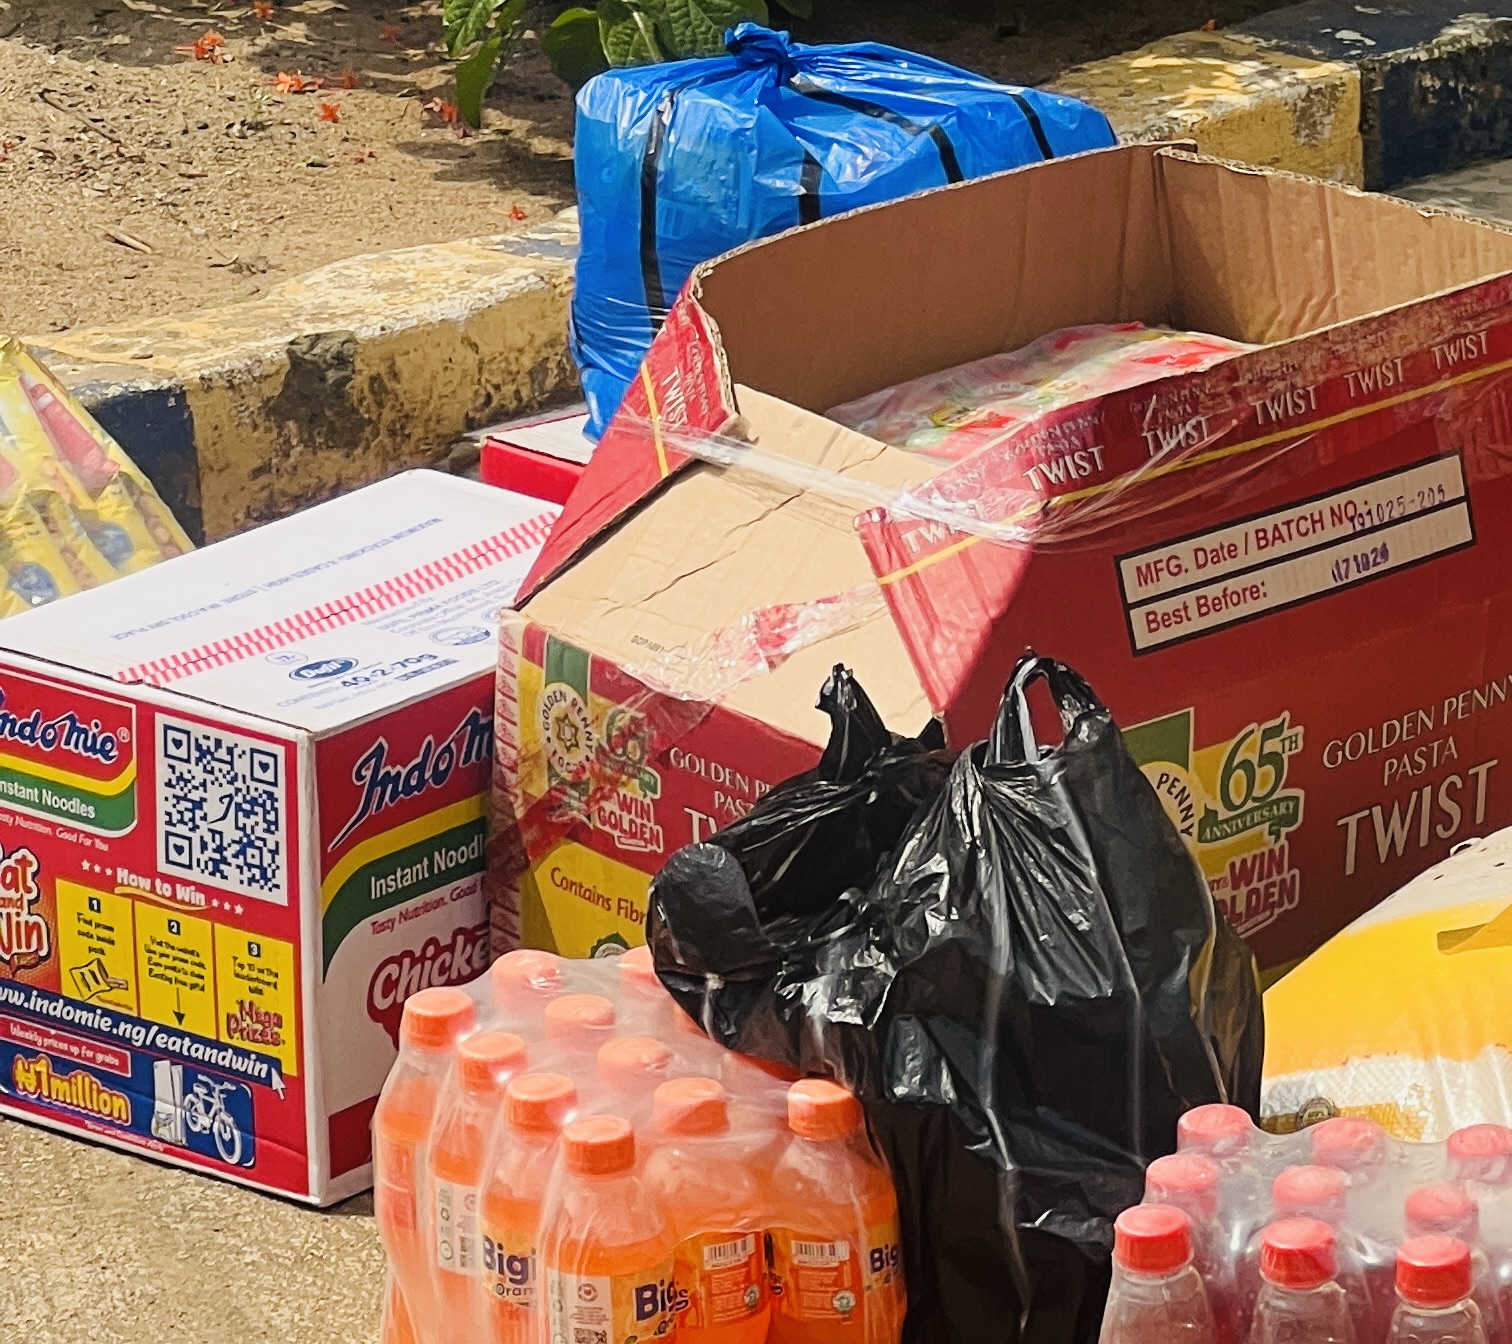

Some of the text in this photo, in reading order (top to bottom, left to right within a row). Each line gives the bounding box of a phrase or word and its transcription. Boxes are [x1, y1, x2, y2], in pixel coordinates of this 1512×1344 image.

[1431, 331, 1488, 370] TWIST
[1343, 358, 1404, 398] TWIST
[1252, 385, 1318, 425] TWIST
[1142, 417, 1209, 456] TWIST
[1023, 446, 1104, 491] TWIST
[1136, 554, 1189, 588] MFG.
[1194, 539, 1238, 570] Date
[1255, 511, 1325, 552] BATCH
[1145, 602, 1192, 634] Best
[1195, 580, 1268, 619] Before:
[542, 689, 567, 732] GOLDEN
[0, 709, 118, 764] ndomie
[1322, 704, 1435, 770] GOLDEN
[670, 747, 749, 793] GOLDEN
[1383, 735, 1458, 787] PASTA
[0, 779, 96, 819] nstant Noodles
[616, 790, 653, 823] WIN
[714, 790, 755, 816] PAS
[1156, 772, 1195, 837] PENNY
[1202, 799, 1297, 840] ANNIVERSARY
[1337, 758, 1498, 877] TWIST
[598, 806, 662, 851] GOLDEN
[0, 855, 33, 894] at
[116, 866, 206, 906] How to Win
[370, 834, 486, 900] Instant Noodl
[1229, 844, 1286, 891] WIN
[370, 916, 395, 936] Tasty
[450, 883, 480, 903] Good
[550, 867, 646, 925] Contains Fibr
[373, 930, 489, 1011] Chicke
[496, 1281, 537, 1298] Oran
